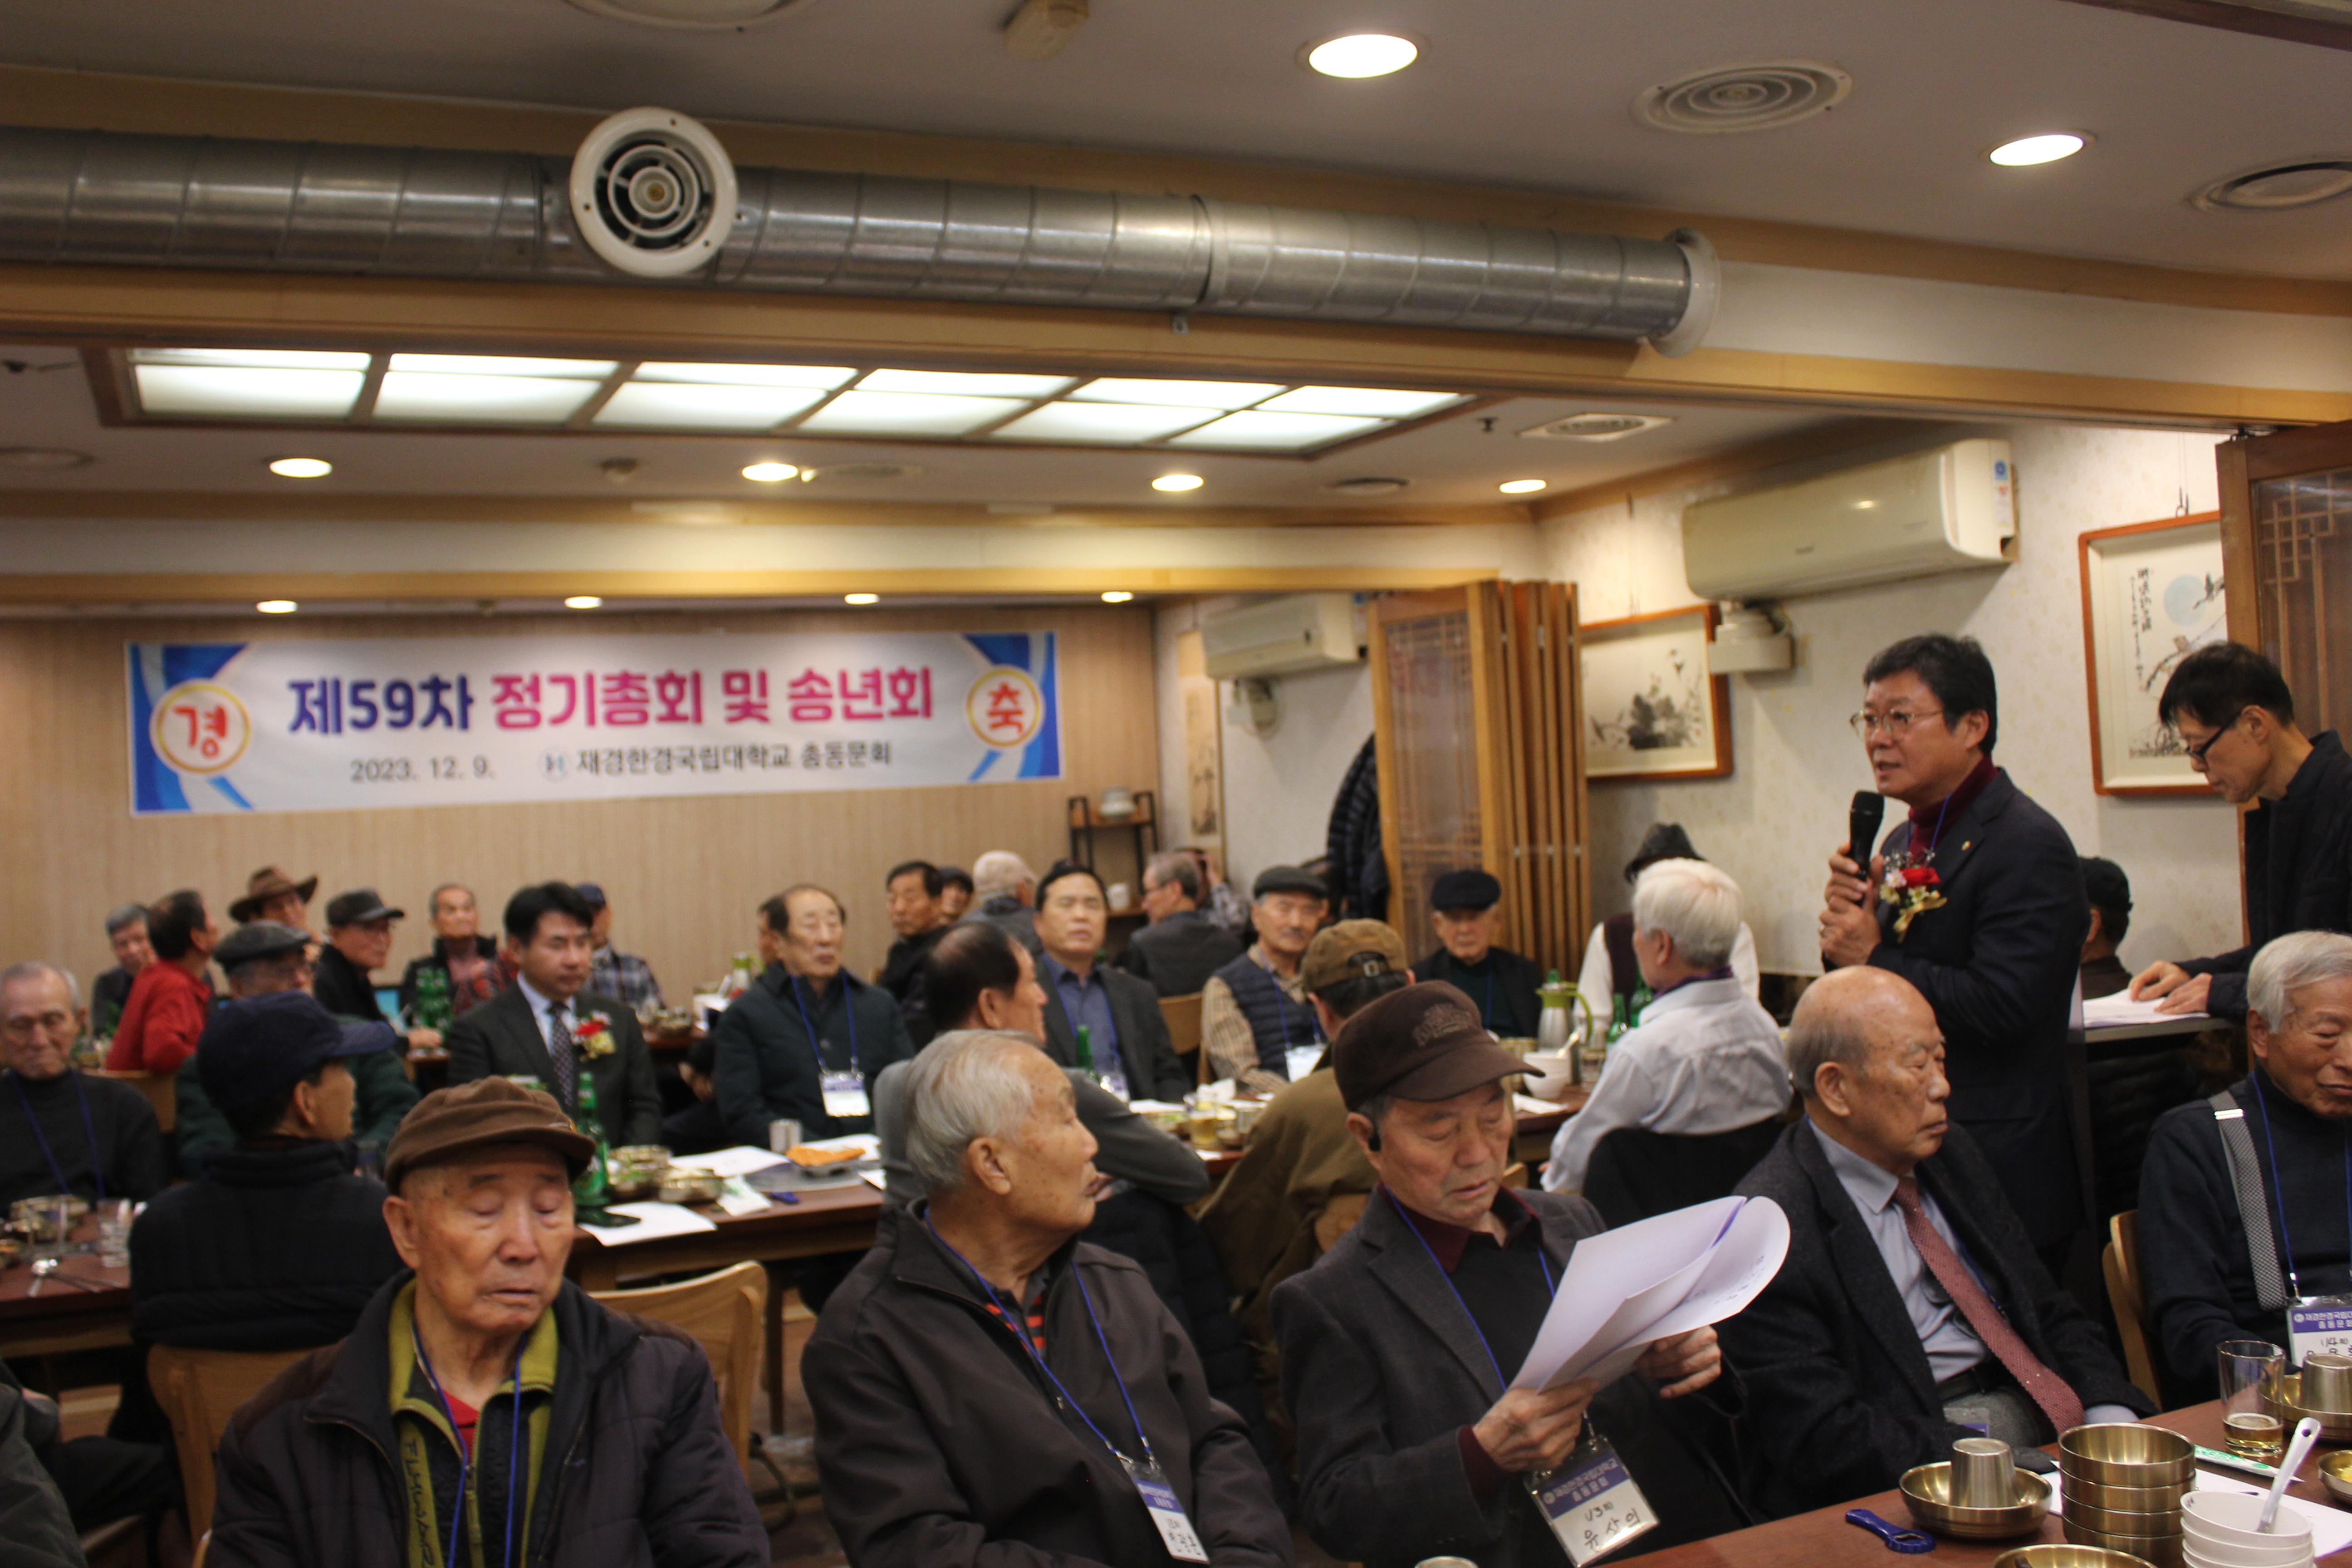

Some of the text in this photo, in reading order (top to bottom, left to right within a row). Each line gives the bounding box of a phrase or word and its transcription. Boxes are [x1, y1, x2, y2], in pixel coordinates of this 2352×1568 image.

[289, 666, 933, 734] 제59차 정기총회 및 송년회
[986, 683, 1024, 734] 축
[174, 705, 228, 760] 경
[351, 759, 417, 783] 2023.
[430, 757, 464, 779] 12.
